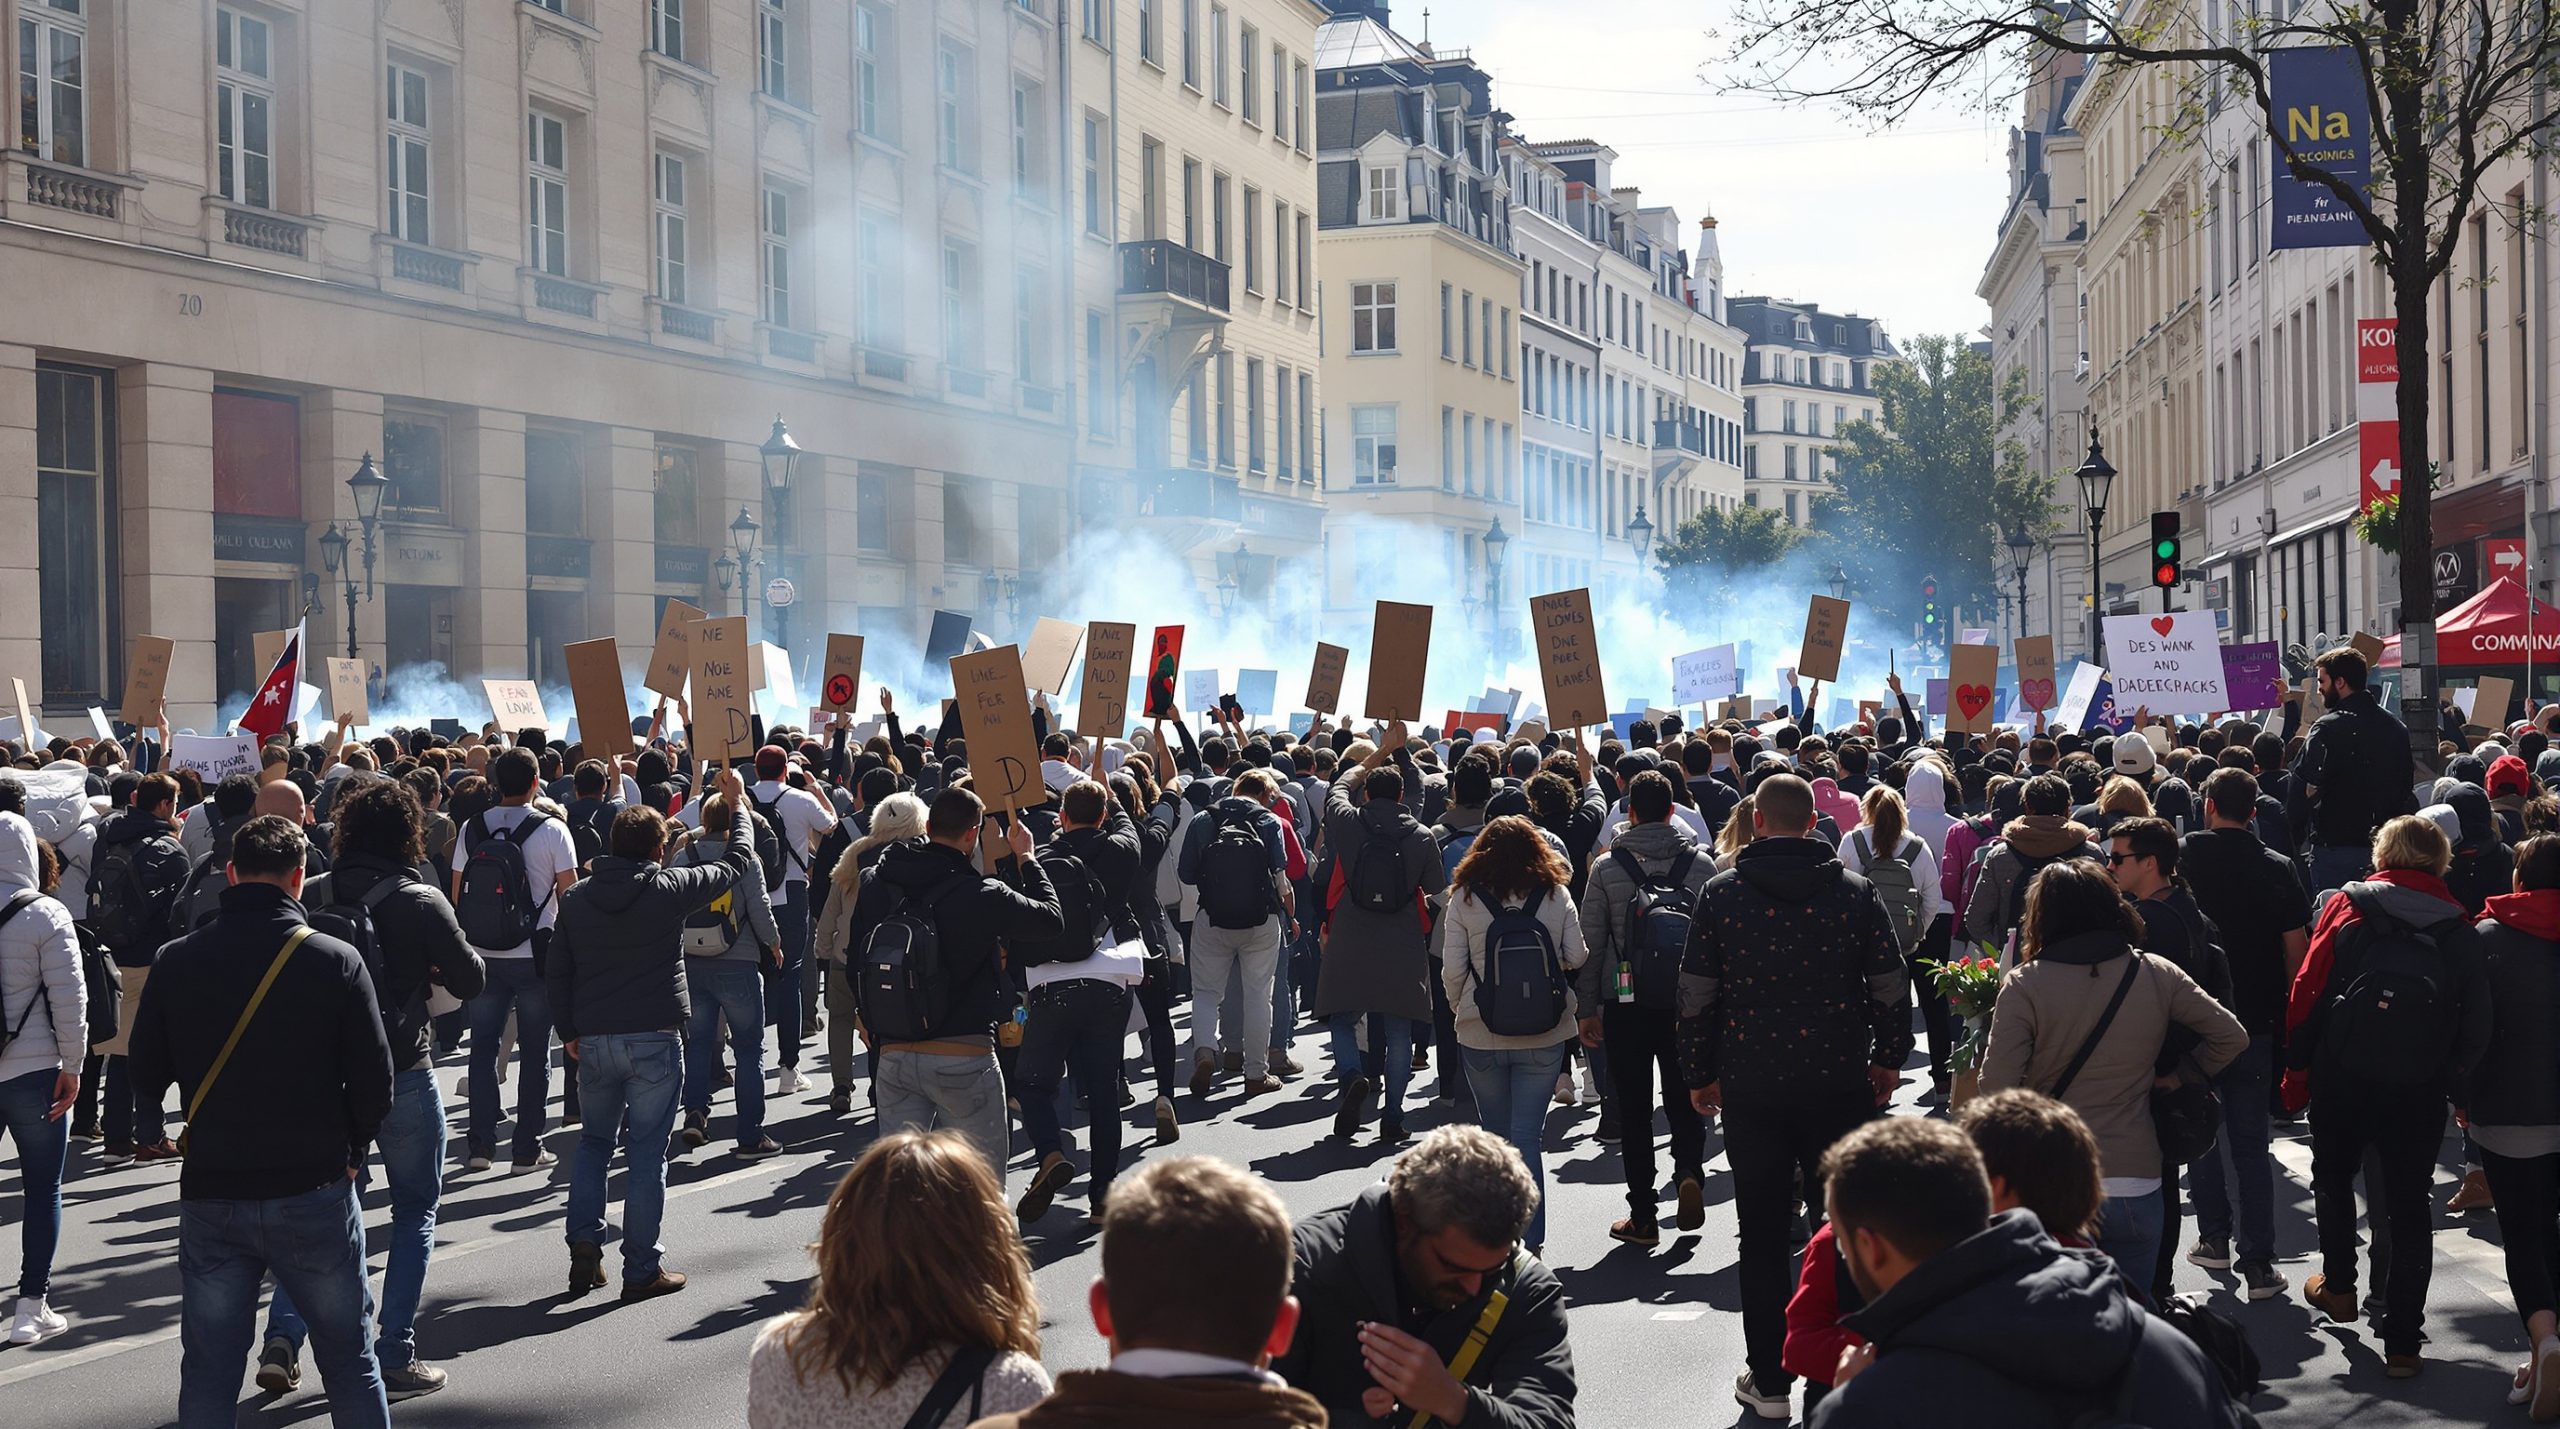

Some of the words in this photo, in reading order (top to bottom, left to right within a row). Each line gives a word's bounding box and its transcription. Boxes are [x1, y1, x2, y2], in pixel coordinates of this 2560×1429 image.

[2287, 104, 2351, 142] Na
[2128, 639, 2157, 653] DES
[2161, 640, 2196, 652] WANK
[2153, 660, 2180, 672] AND
